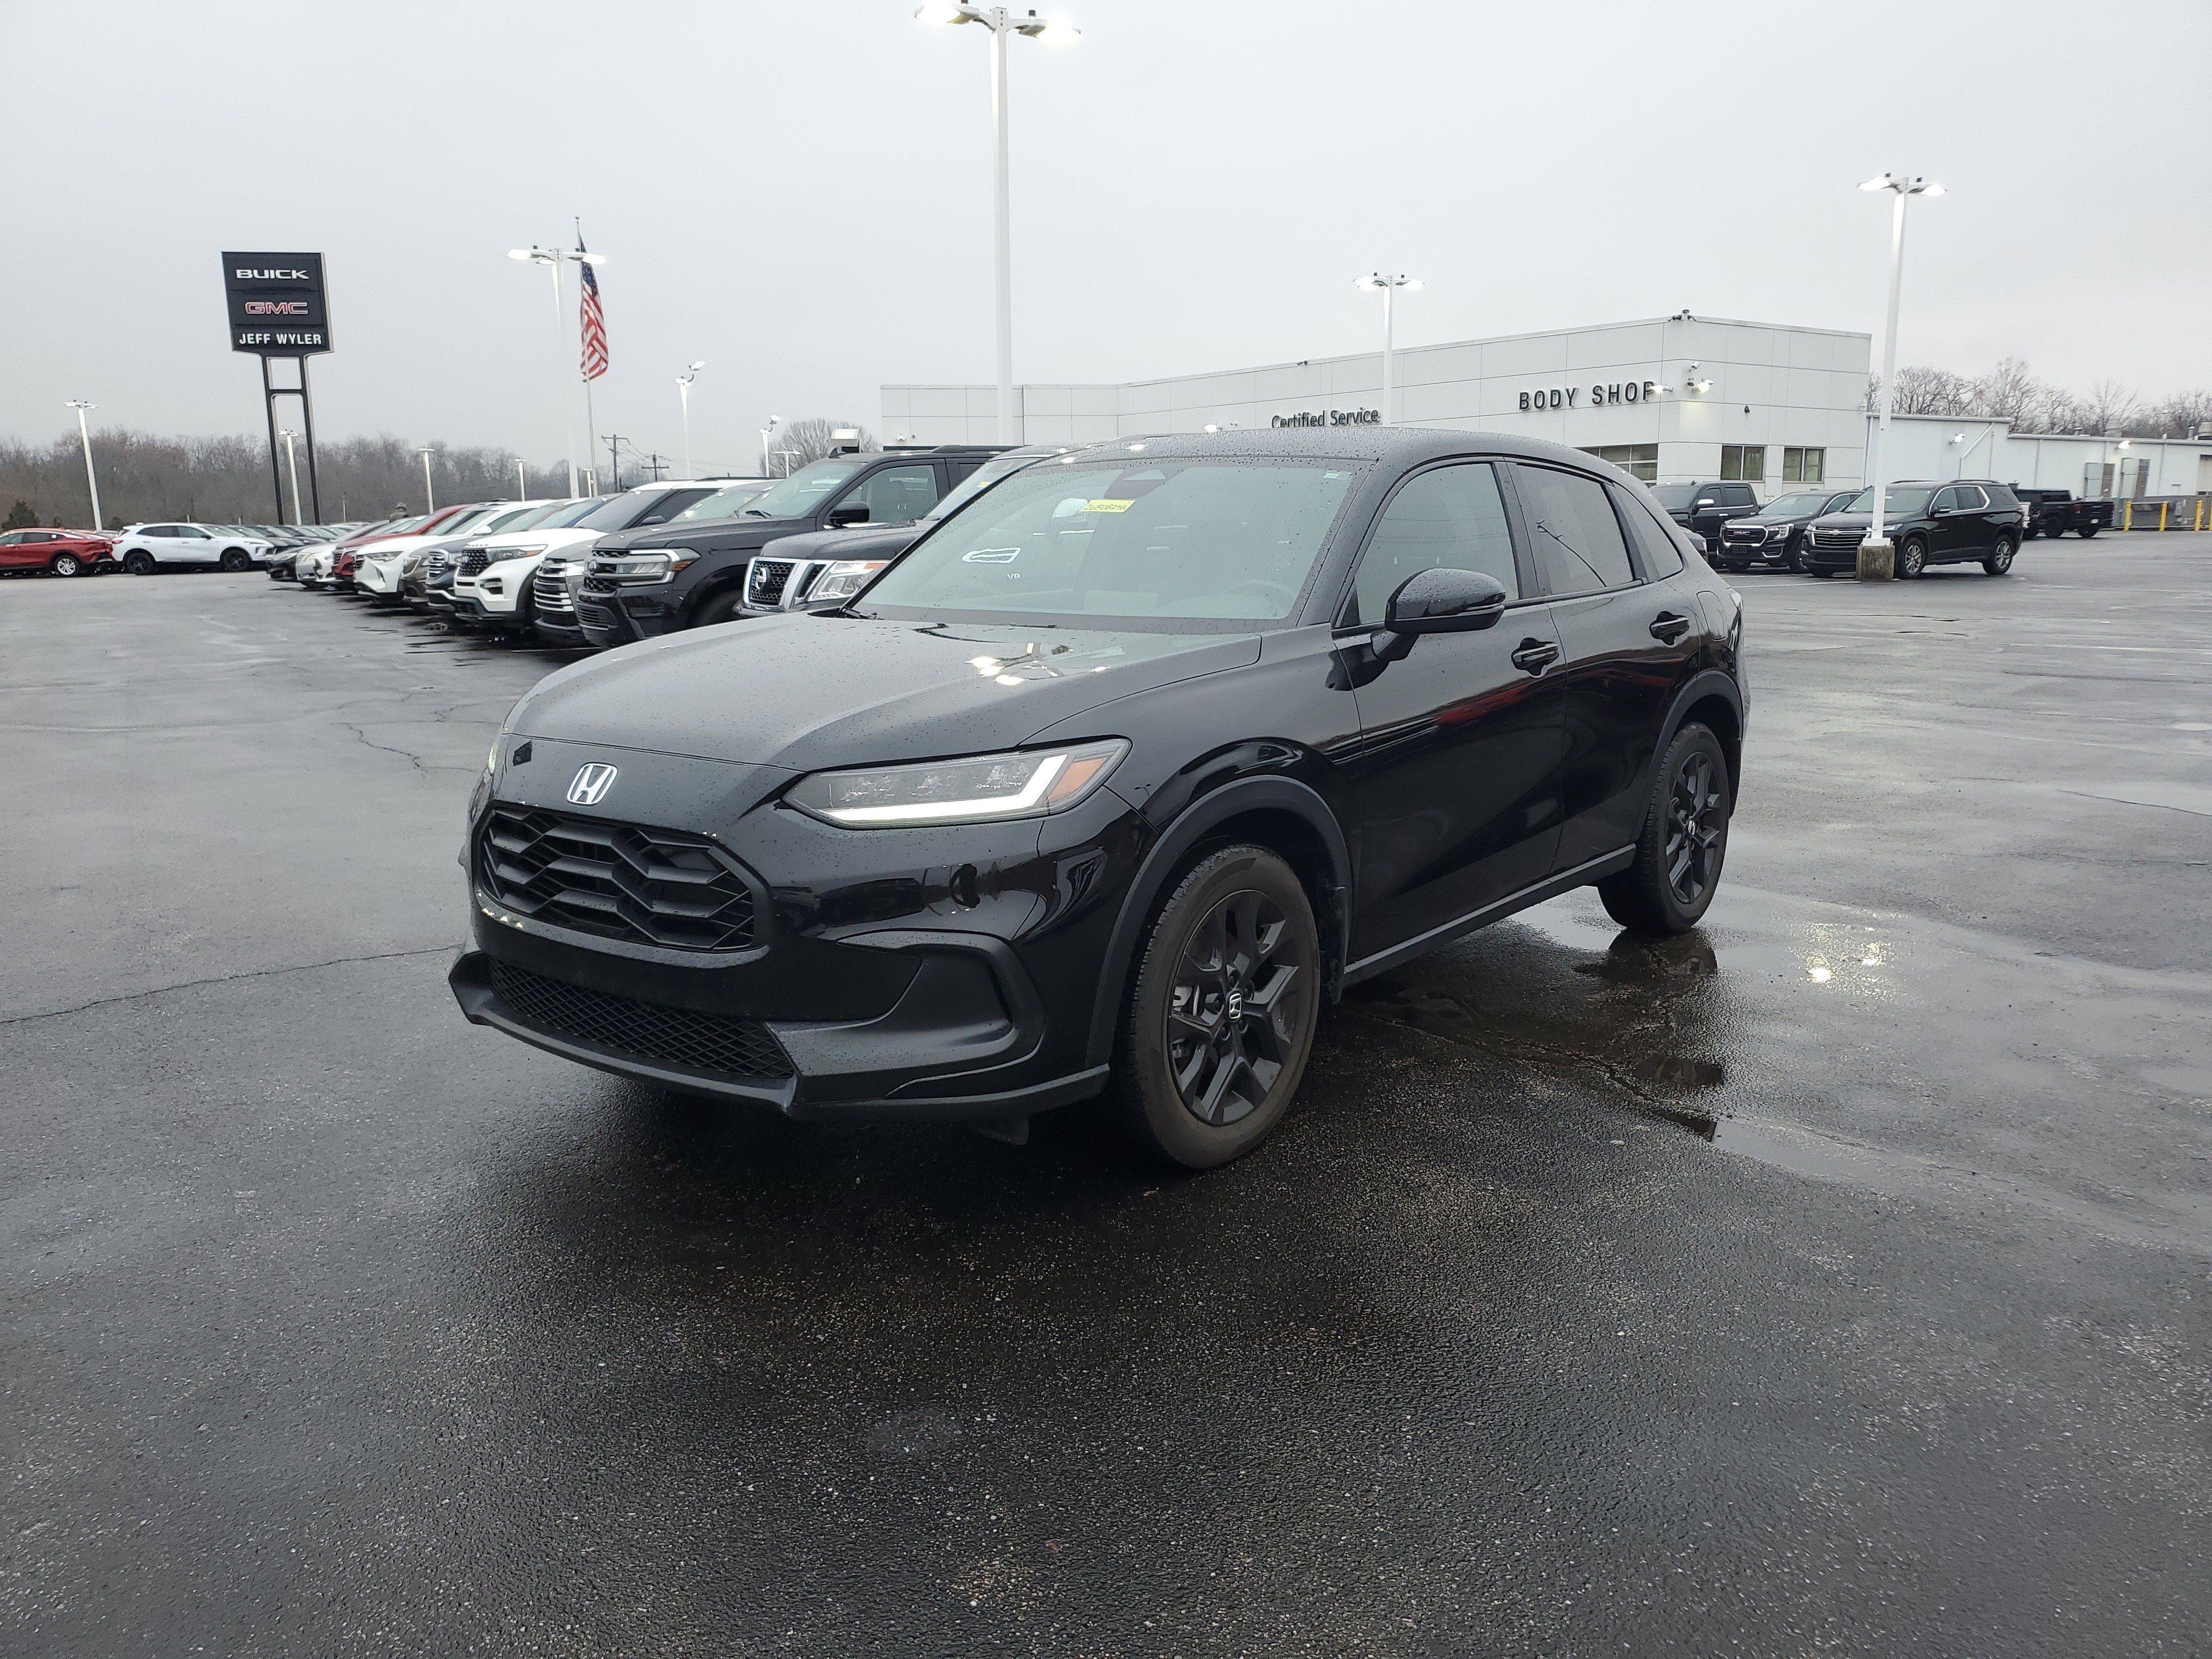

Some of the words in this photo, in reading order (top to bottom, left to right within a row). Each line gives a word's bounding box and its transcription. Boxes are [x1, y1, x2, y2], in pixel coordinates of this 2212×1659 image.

[236, 269, 310, 279] BUICK
[245, 302, 308, 314] GMC
[239, 333, 271, 345] JEFF
[276, 333, 321, 345] WYLER
[1519, 387, 1578, 410] BODY
[1592, 381, 1656, 405] SHOP
[1271, 410, 1325, 428] Certified
[1330, 407, 1380, 426] Service
